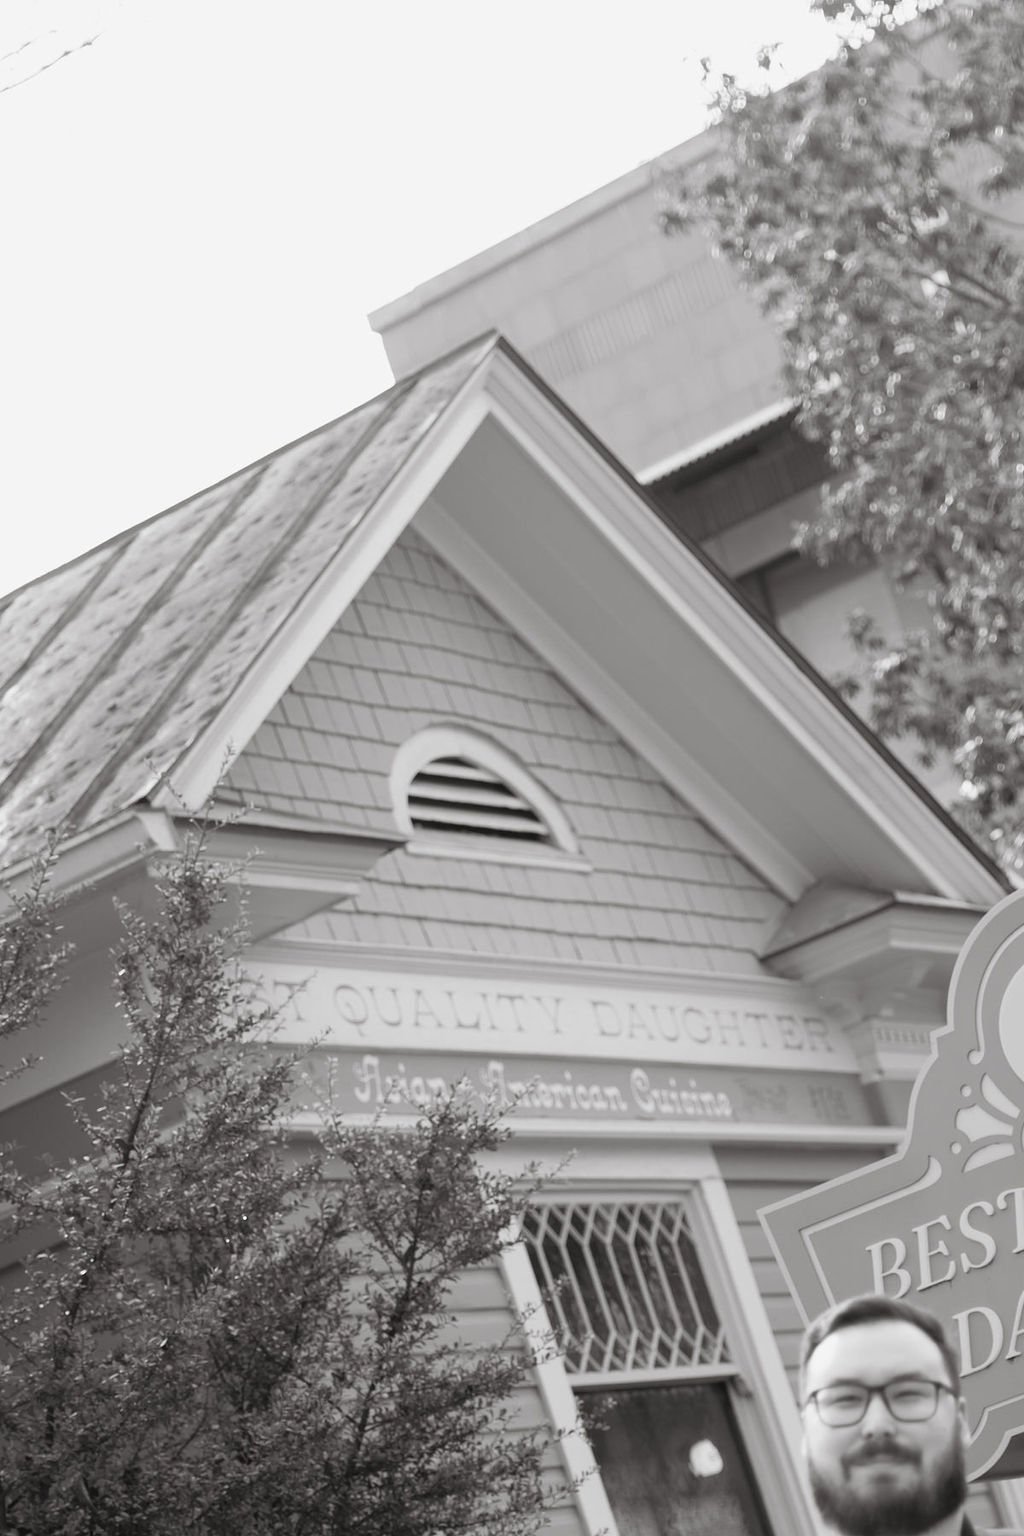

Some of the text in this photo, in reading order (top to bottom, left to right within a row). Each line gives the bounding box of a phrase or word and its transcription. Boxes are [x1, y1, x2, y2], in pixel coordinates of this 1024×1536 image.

[334, 985, 563, 1036] QUALITY
[591, 1000, 836, 1052] DAUGHTER
[352, 1054, 450, 1104] Asian
[479, 1060, 629, 1112] American
[630, 1068, 733, 1117] Cuisine
